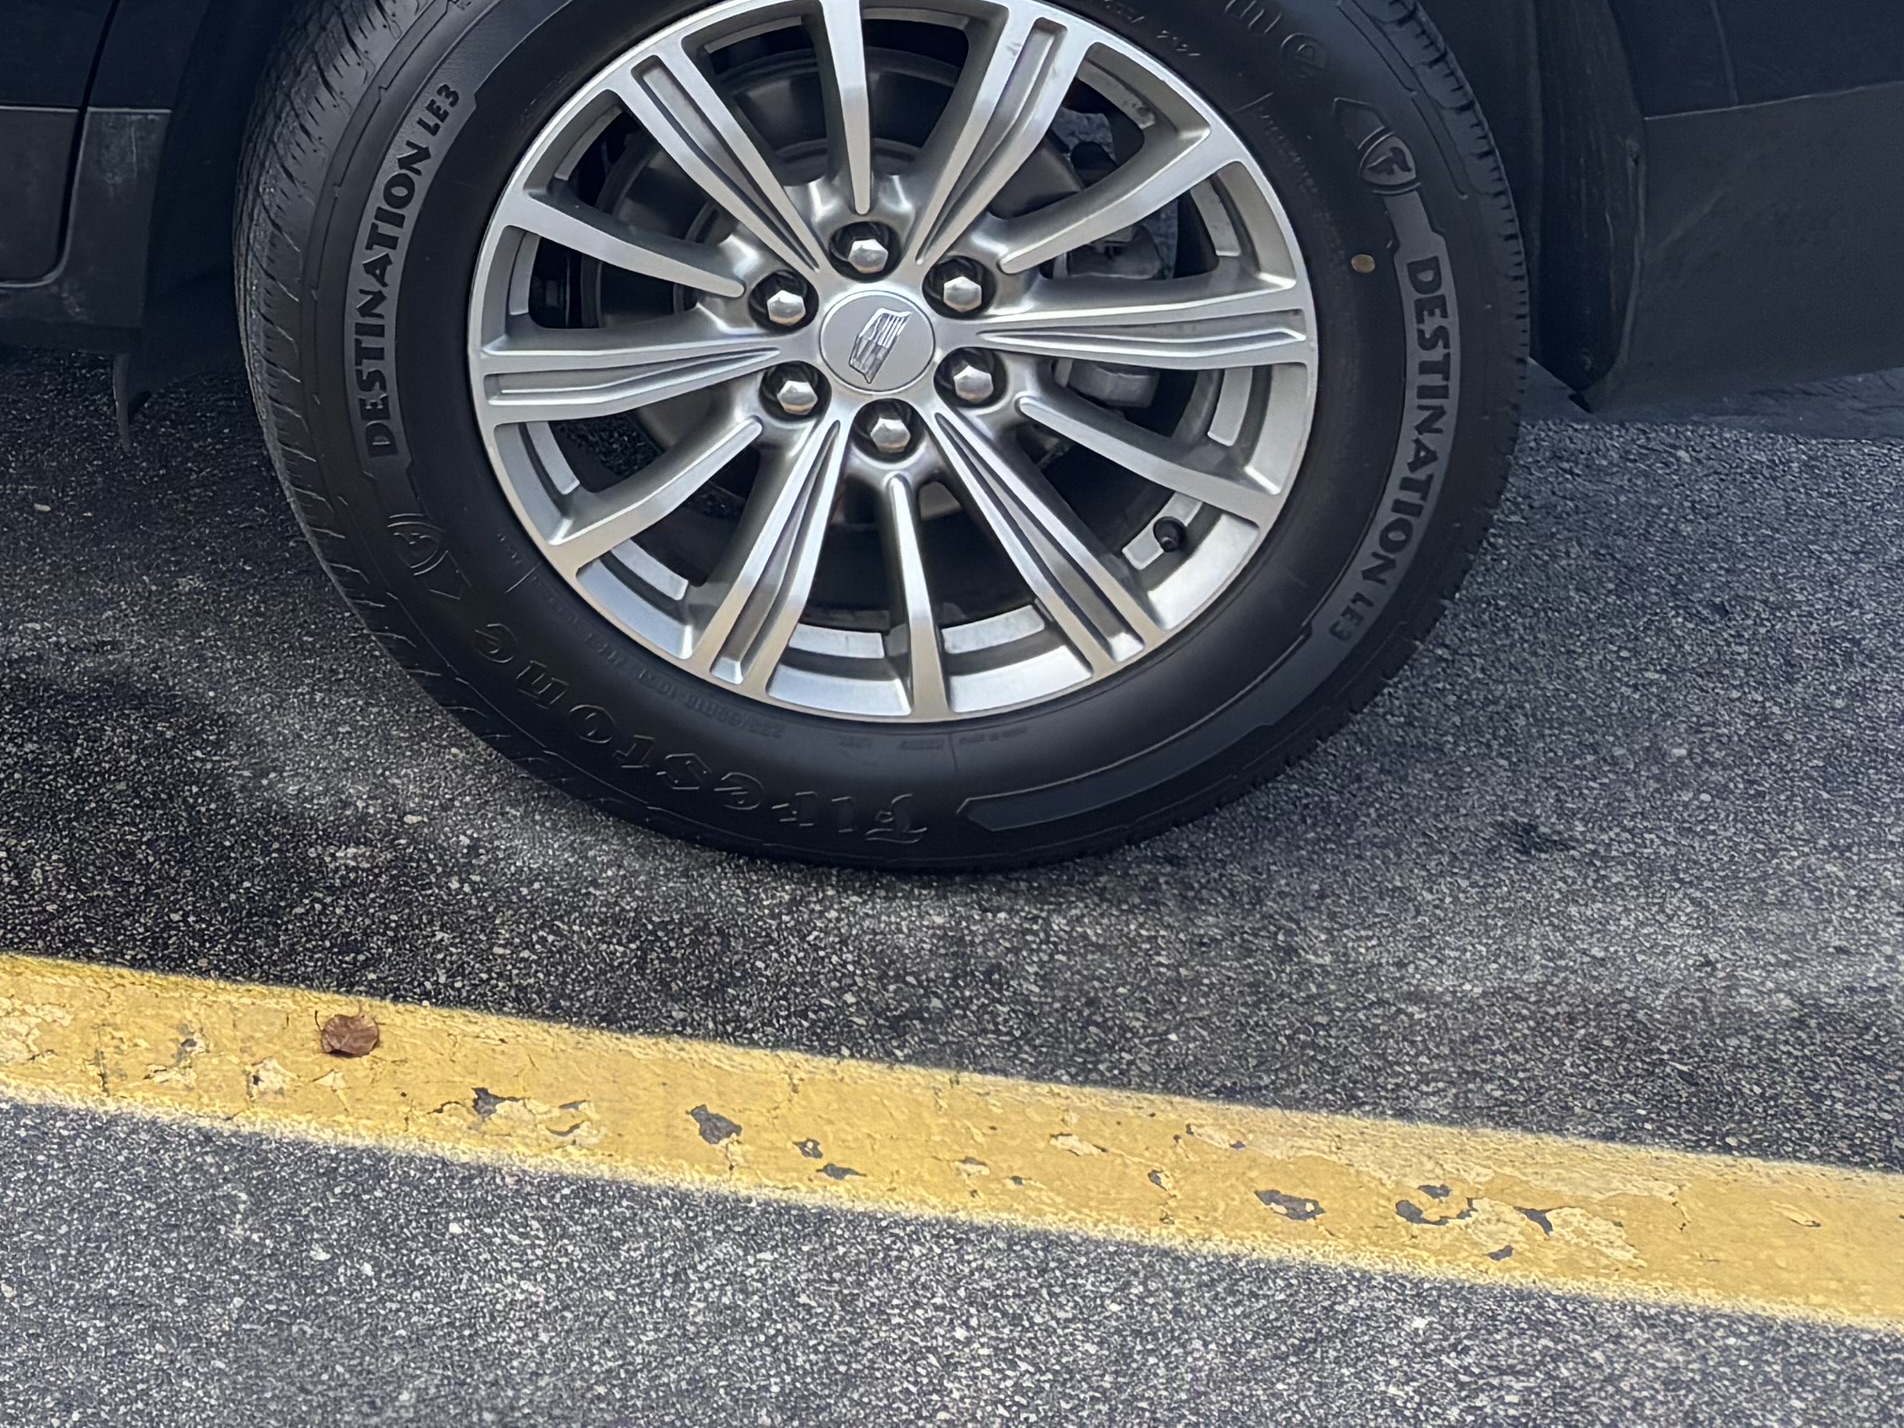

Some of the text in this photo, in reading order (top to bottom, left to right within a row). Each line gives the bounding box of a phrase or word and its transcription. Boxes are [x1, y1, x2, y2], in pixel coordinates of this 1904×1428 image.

[353, 82, 461, 458] DESTINATION LE3
[1329, 254, 1450, 643] DESTINATION LE3
[473, 618, 929, 846] Firestone
